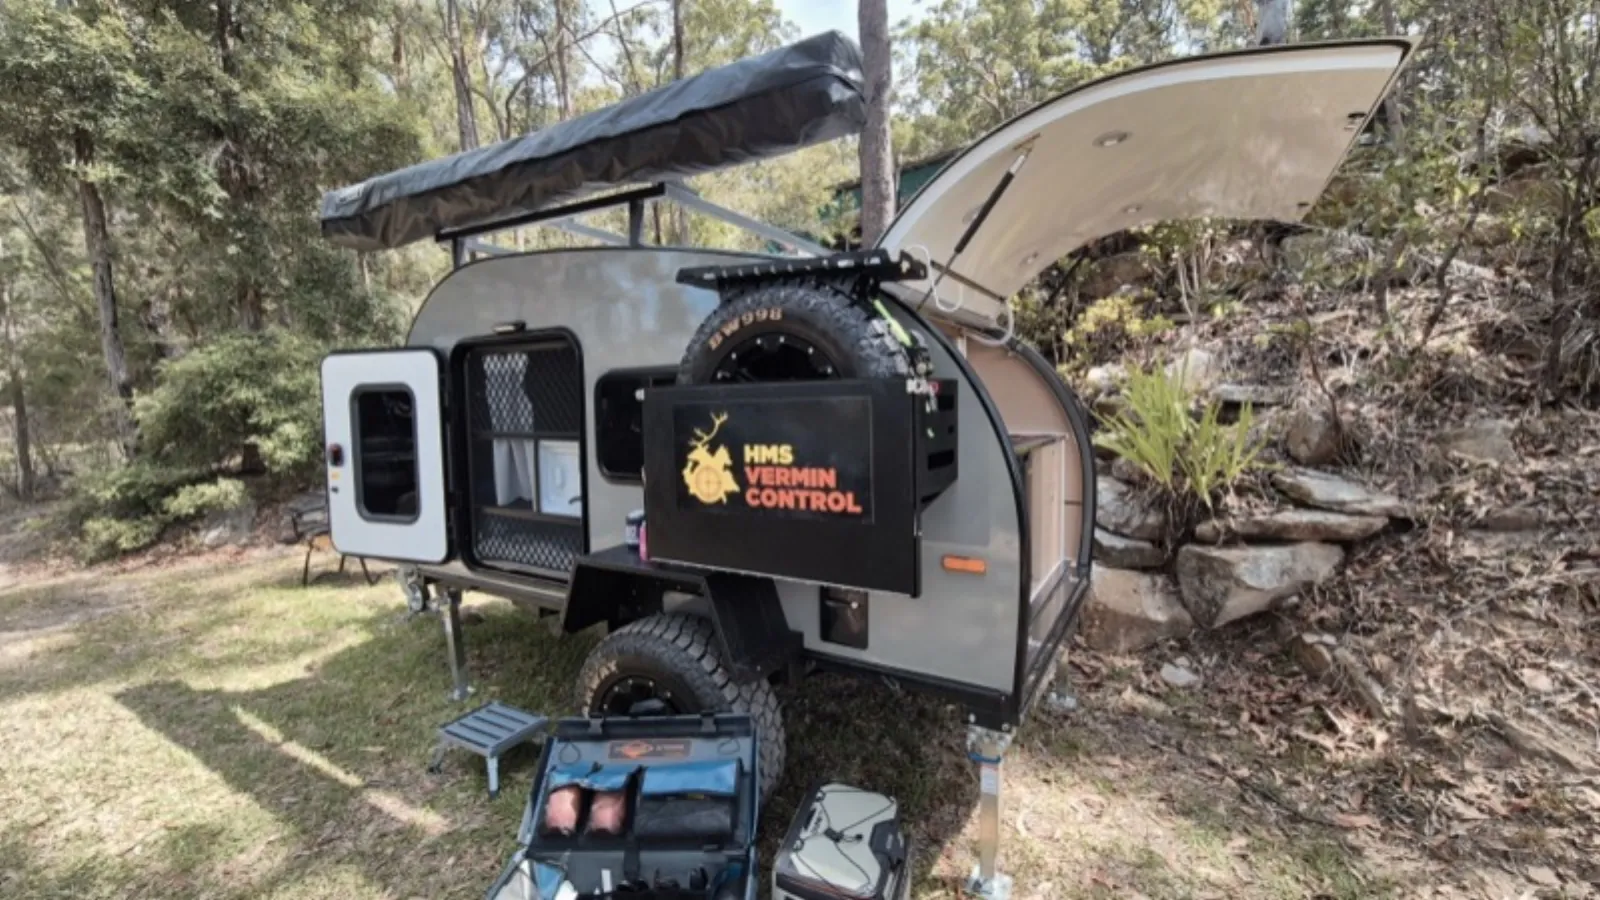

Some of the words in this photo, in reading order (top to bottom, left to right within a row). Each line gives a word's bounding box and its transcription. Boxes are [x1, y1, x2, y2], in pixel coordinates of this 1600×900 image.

[743, 444, 793, 465] HMS
[744, 466, 836, 489] VERMIN
[745, 487, 862, 514] CONTROL
